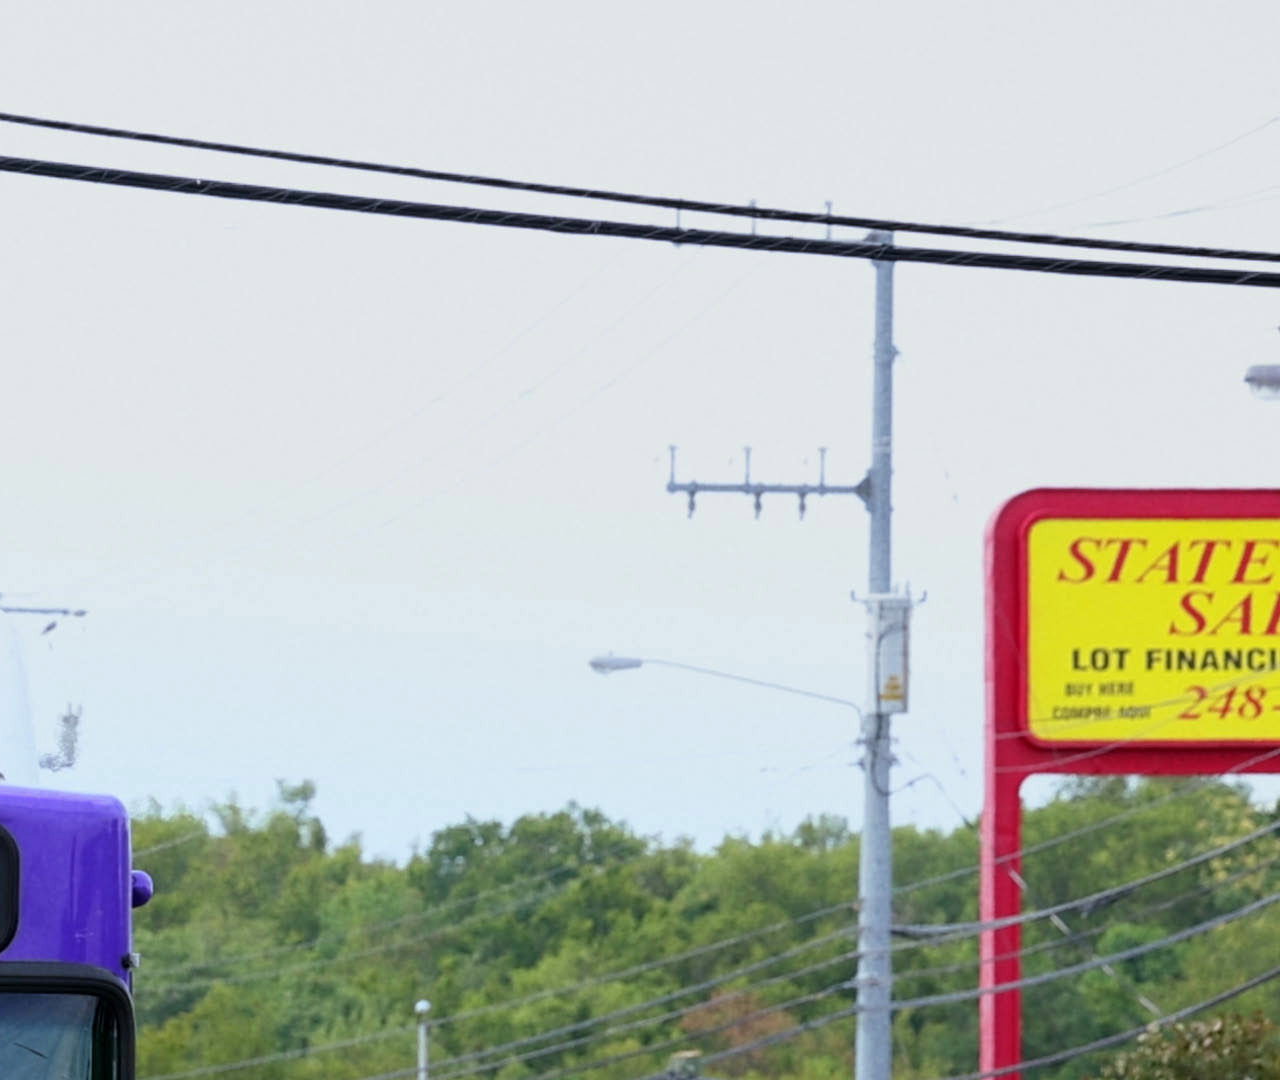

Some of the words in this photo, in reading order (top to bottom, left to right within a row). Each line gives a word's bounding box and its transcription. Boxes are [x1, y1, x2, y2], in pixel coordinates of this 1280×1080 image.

[1057, 536, 1280, 586] STATE
[1072, 649, 1131, 671] LOT
[1145, 649, 1278, 671] FINANCI
